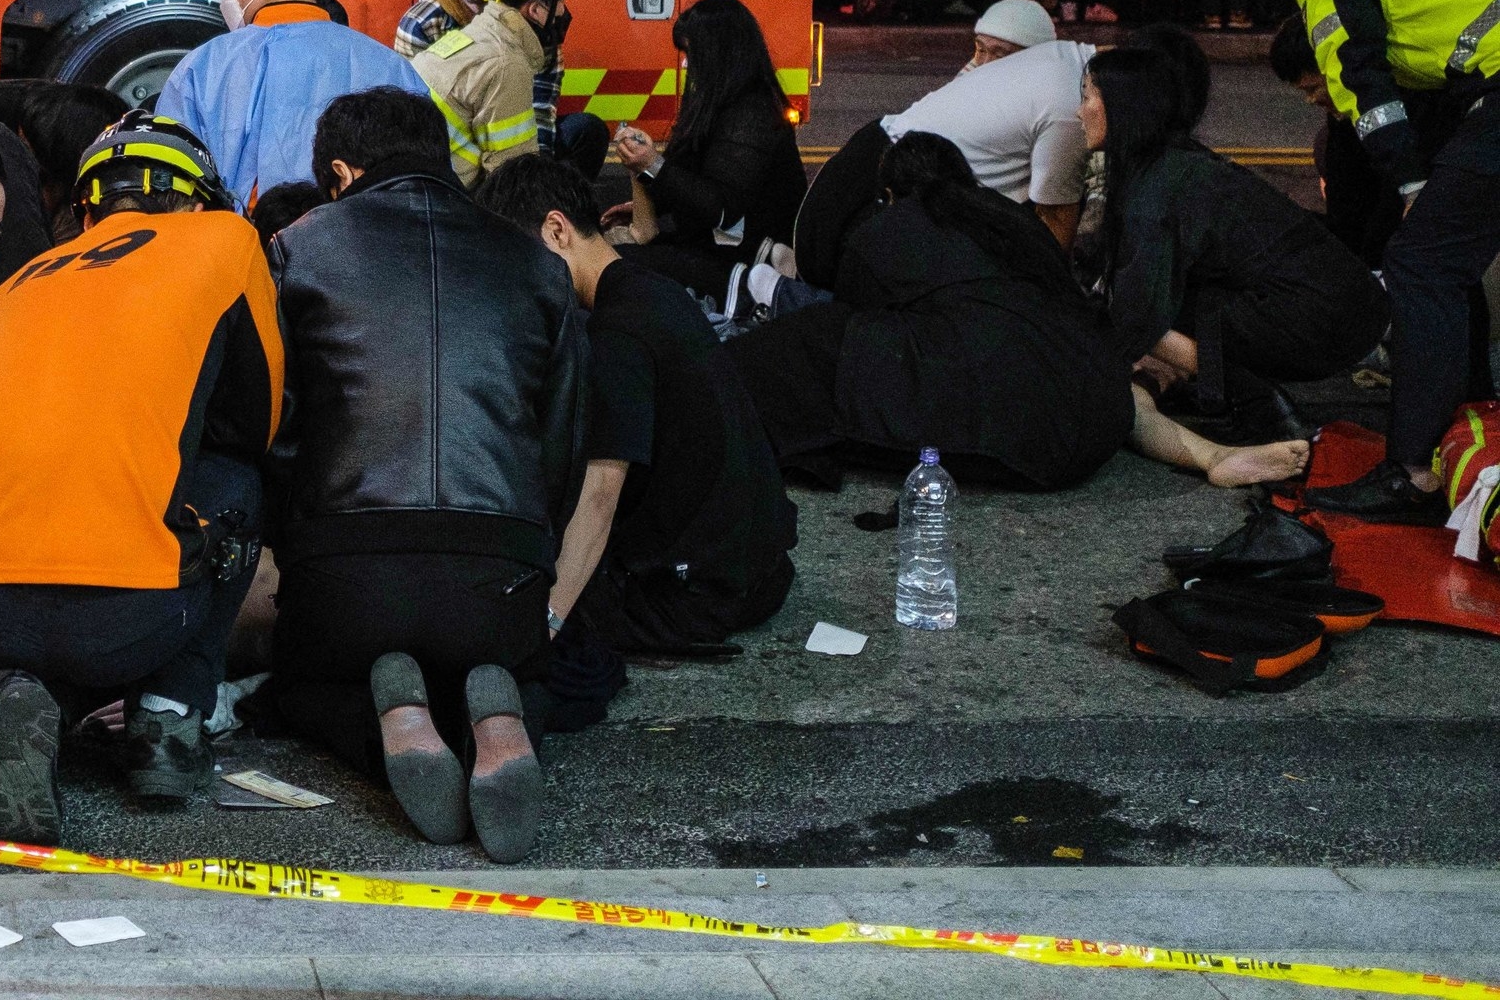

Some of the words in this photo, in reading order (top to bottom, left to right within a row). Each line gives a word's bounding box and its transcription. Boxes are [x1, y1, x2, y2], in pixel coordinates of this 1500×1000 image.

[8, 229, 157, 294] 119
[201, 858, 256, 890] FIRE
[267, 864, 324, 898] LINE
